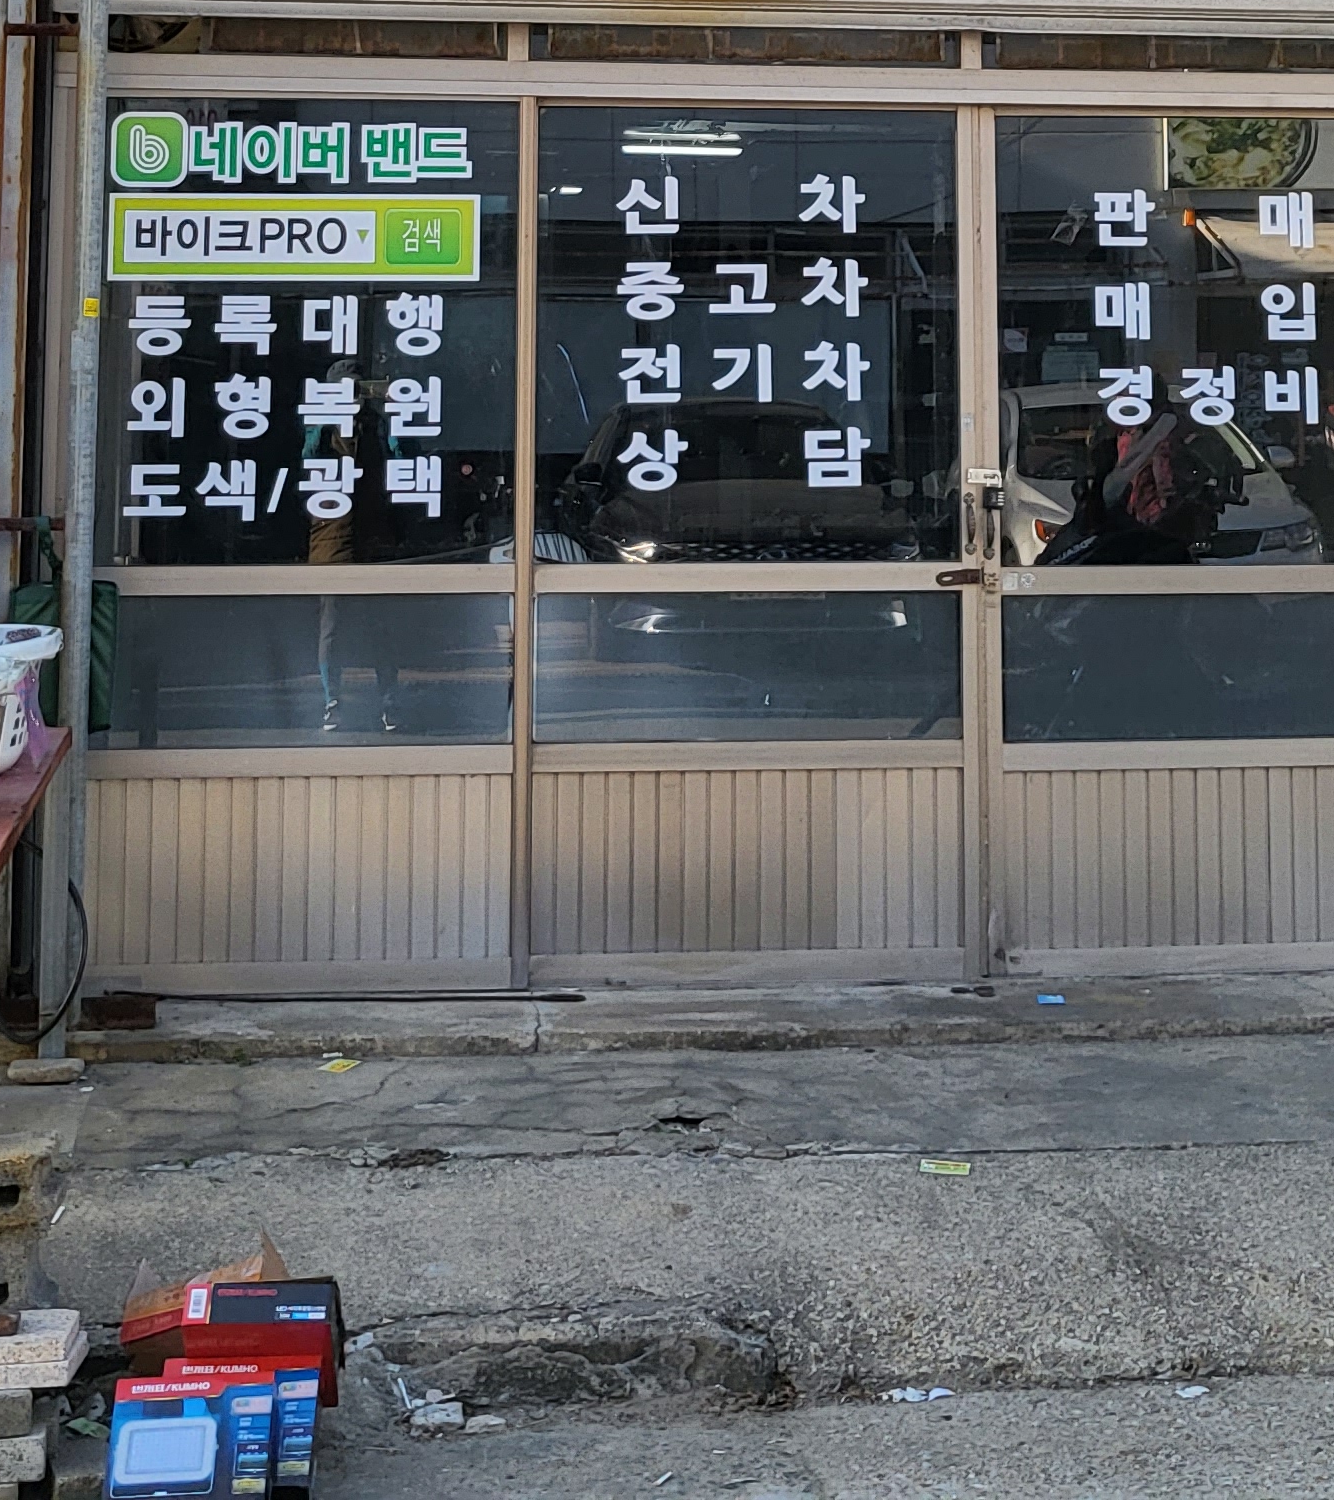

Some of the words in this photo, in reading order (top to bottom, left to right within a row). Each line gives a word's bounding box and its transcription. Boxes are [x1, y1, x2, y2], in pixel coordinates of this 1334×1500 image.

[188, 121, 351, 185] 네이버
[361, 122, 473, 184] 밴드
[134, 214, 348, 257] 바이크PRO
[401, 218, 443, 254] 검색
